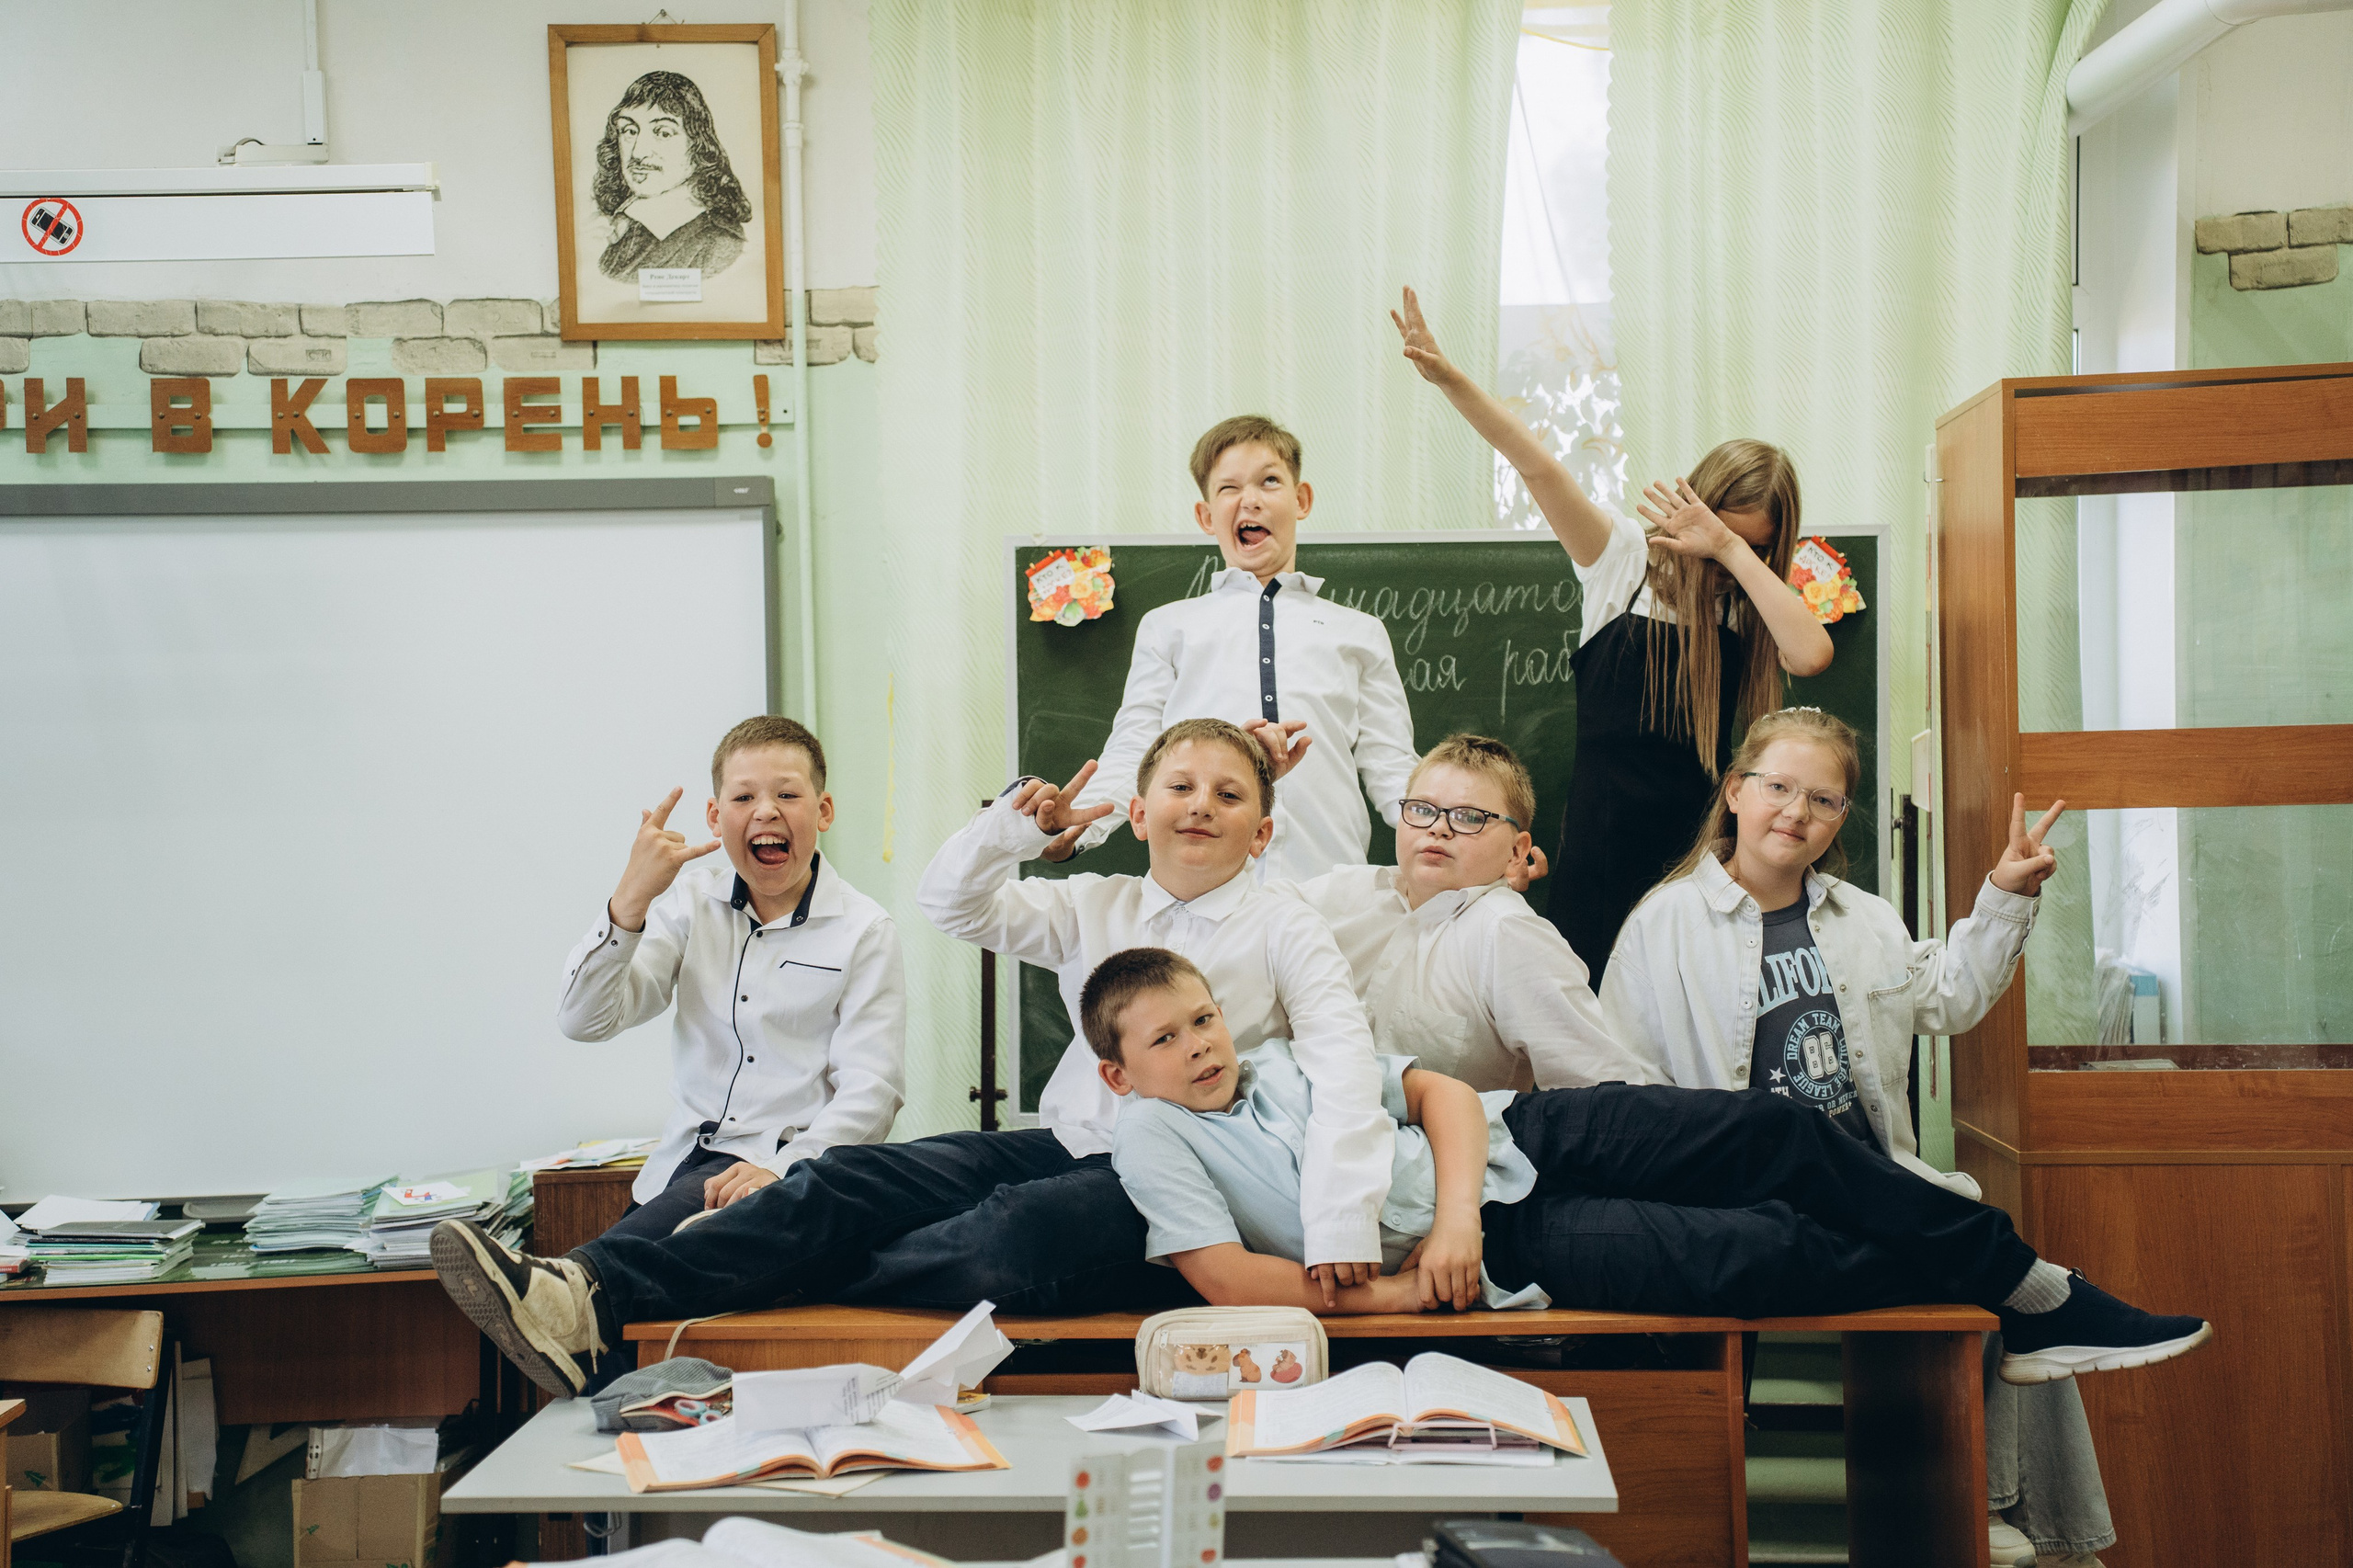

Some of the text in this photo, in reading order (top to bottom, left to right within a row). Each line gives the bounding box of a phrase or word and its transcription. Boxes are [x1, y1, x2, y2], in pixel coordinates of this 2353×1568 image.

[0, 378, 87, 453] И
[151, 378, 212, 452] В
[1500, 629, 1583, 725] раб
[1787, 1017, 1811, 1061] DREAM
[1812, 1013, 1841, 1034] TEAM
[1792, 1071, 1835, 1097] LEAGUE
